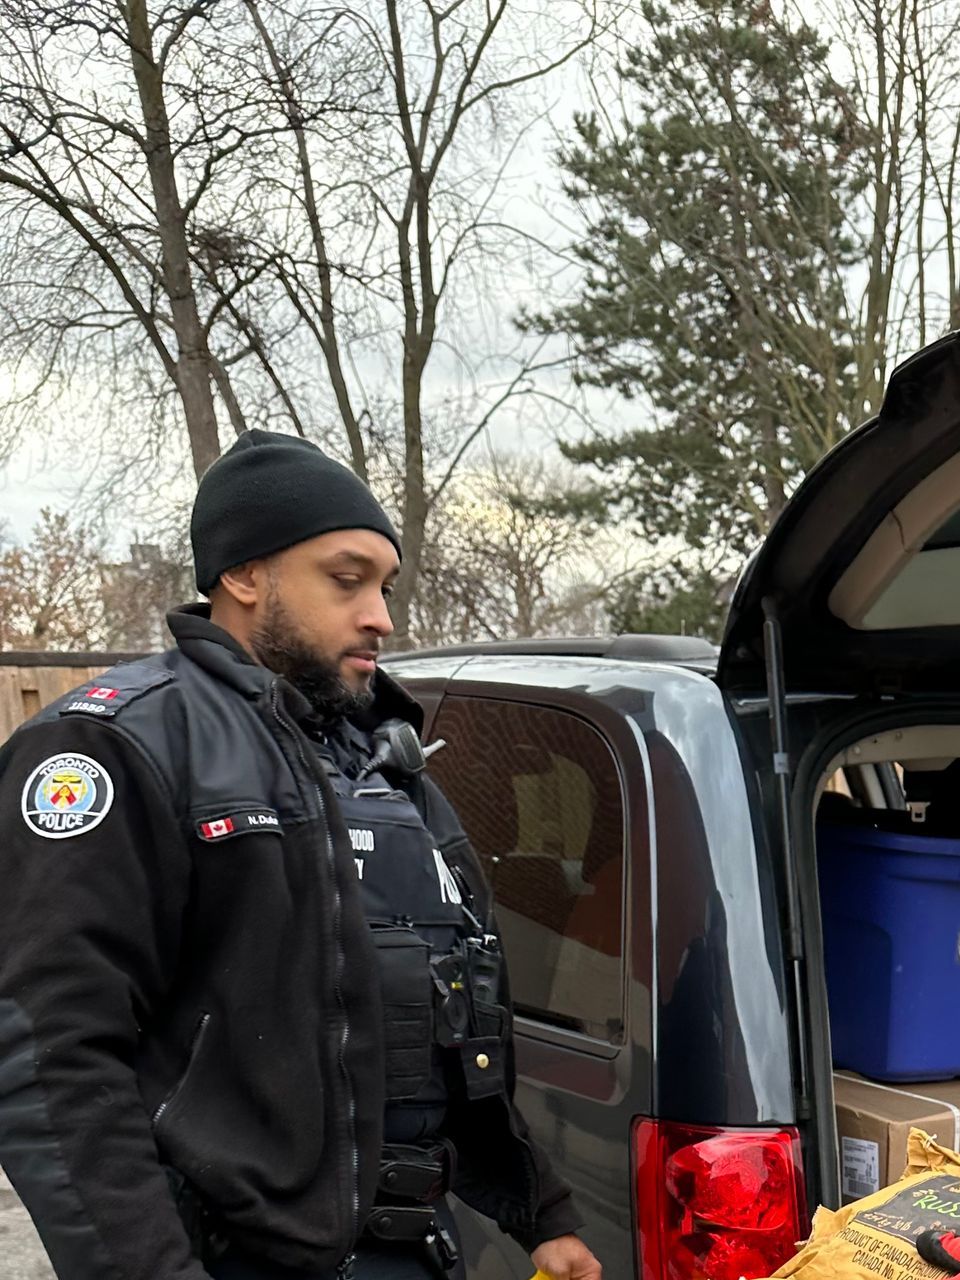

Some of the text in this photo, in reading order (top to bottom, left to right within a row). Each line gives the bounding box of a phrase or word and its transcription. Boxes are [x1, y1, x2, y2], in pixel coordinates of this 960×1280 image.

[39, 757, 100, 780] TORONTO
[38, 813, 84, 831] POLICE
[835, 1228, 872, 1250] PRODUCT
[869, 1239, 881, 1255] OF
[852, 1249, 881, 1274] CANADA
